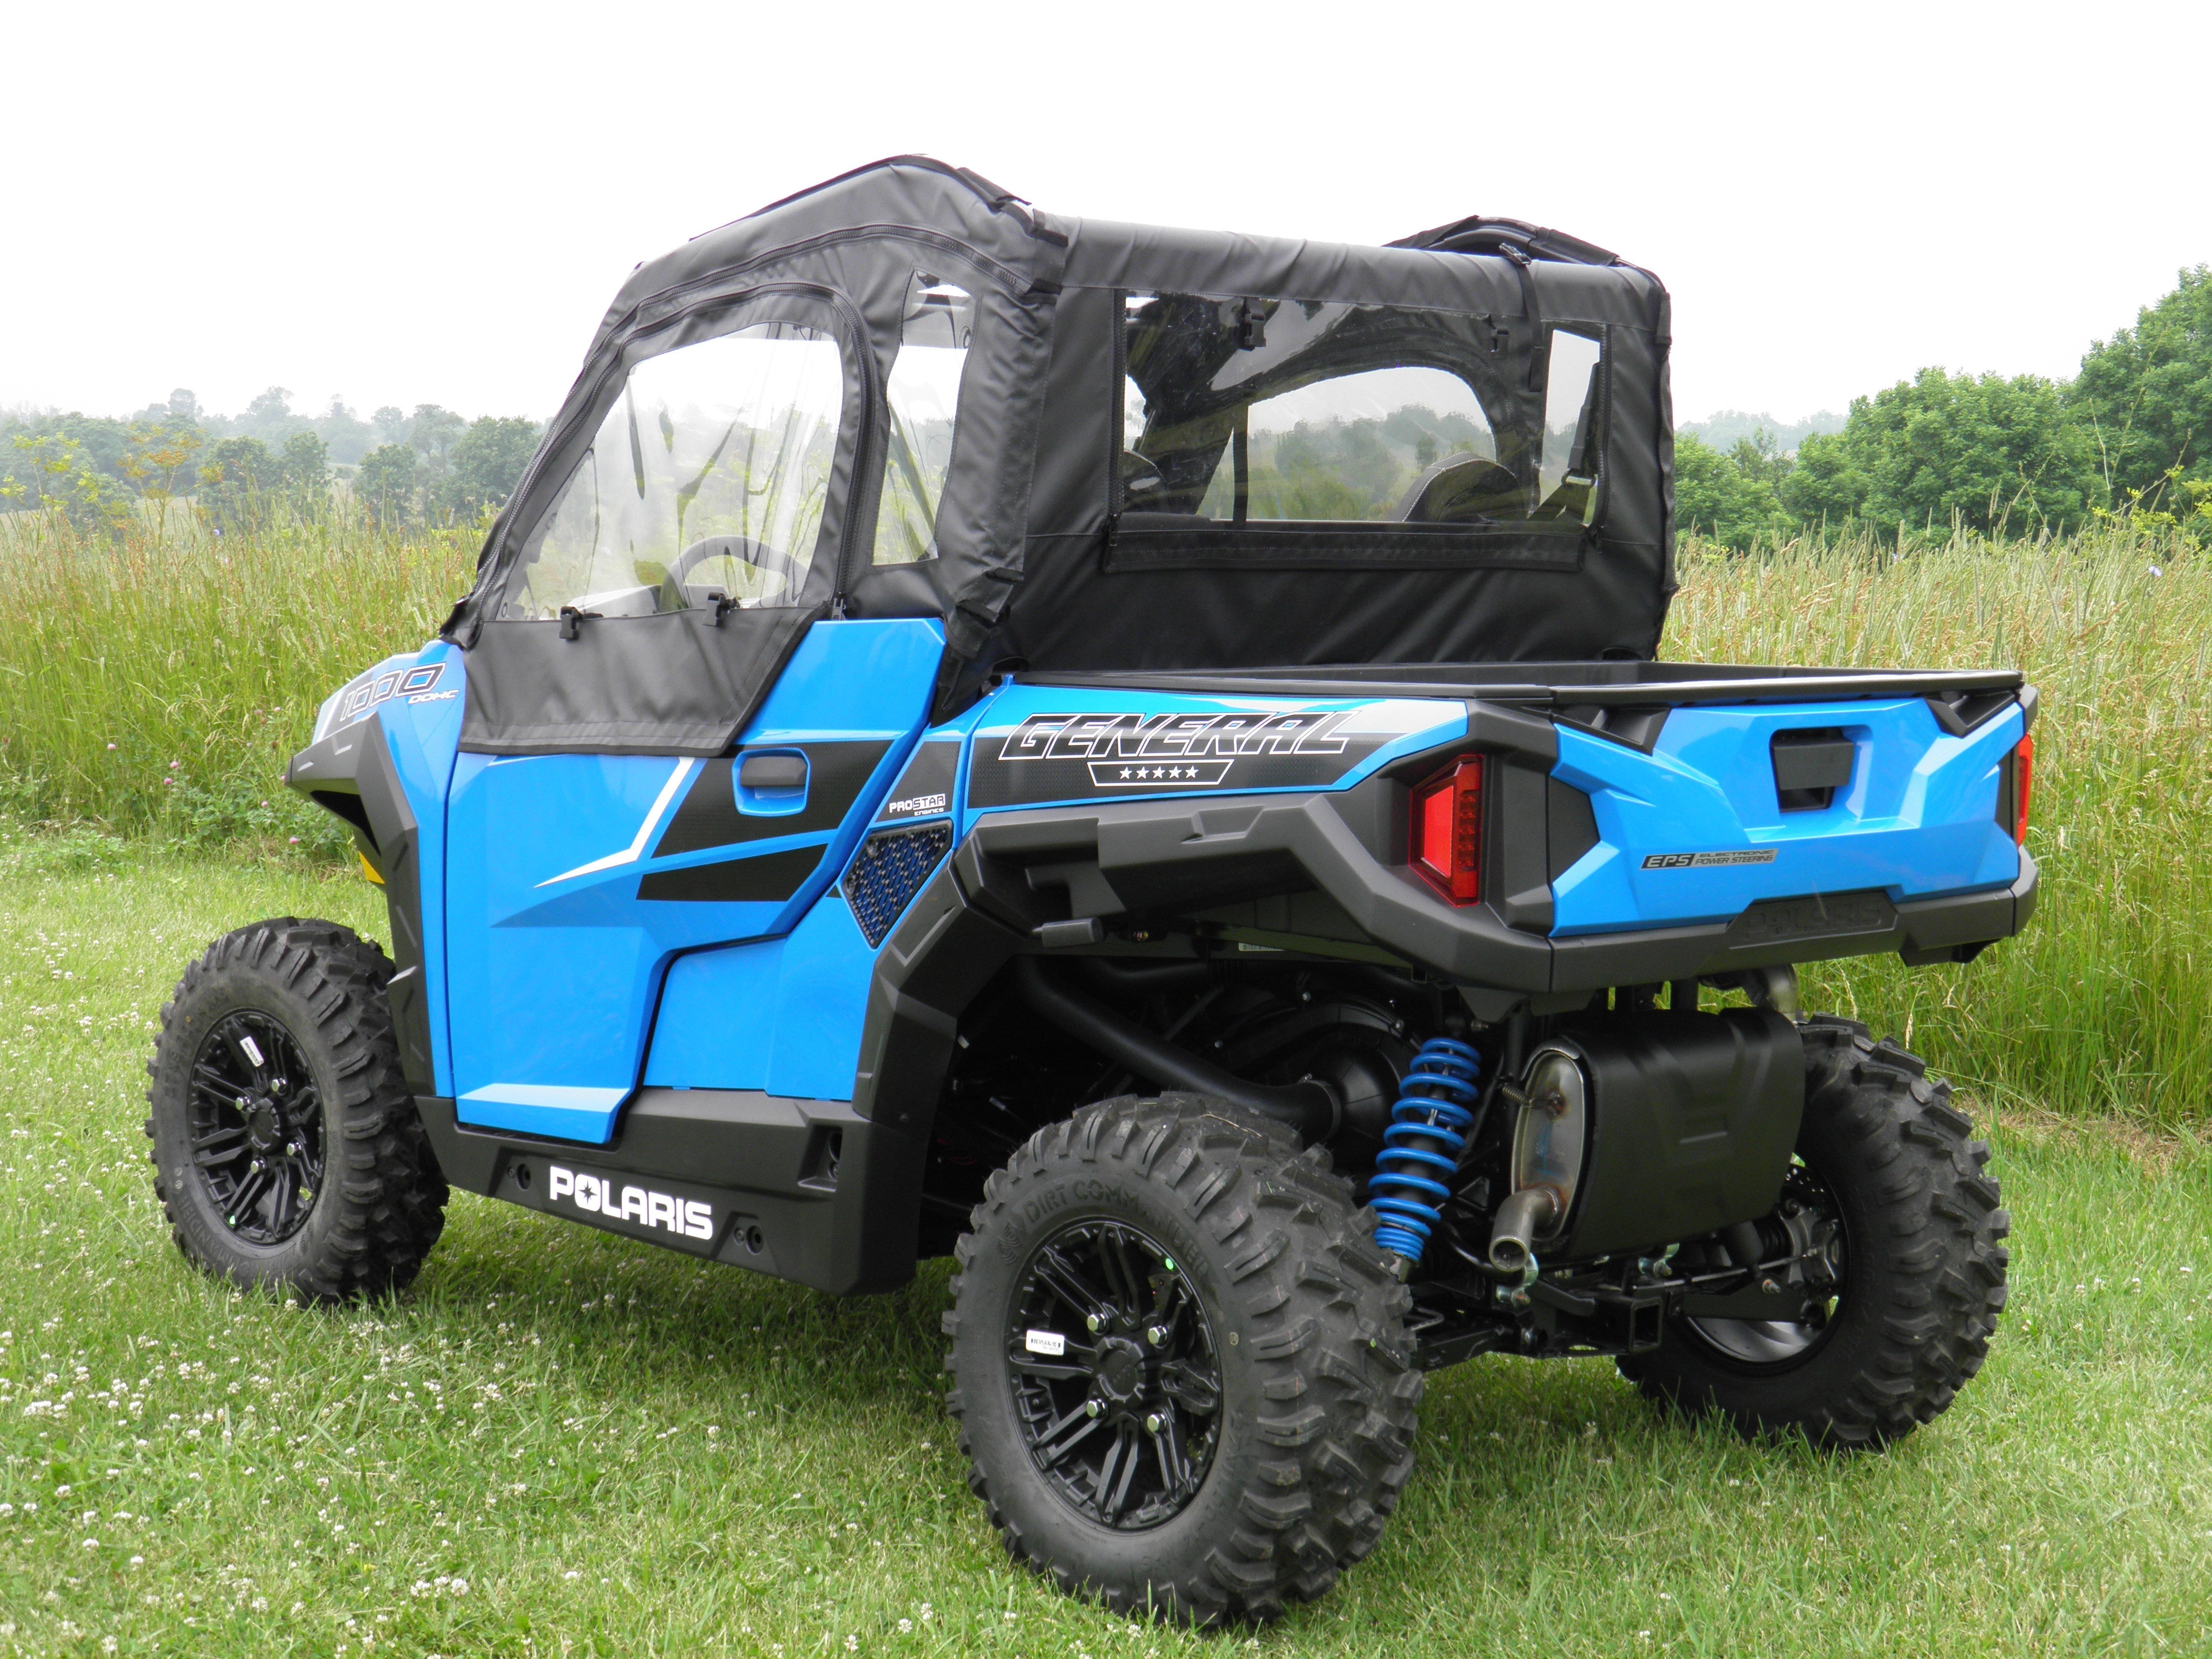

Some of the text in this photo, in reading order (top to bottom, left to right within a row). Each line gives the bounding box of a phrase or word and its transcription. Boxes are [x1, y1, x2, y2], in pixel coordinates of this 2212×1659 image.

[339, 662, 446, 722] 1000
[408, 689, 459, 705] DOHC
[998, 710, 1363, 760] GENERAL
[889, 793, 946, 814] PROSTAR
[1646, 854, 1691, 868] EPS
[1731, 855, 1774, 863] STEERING
[549, 1165, 713, 1240] POLARIS
[1023, 1183, 1069, 1223] DIRT
